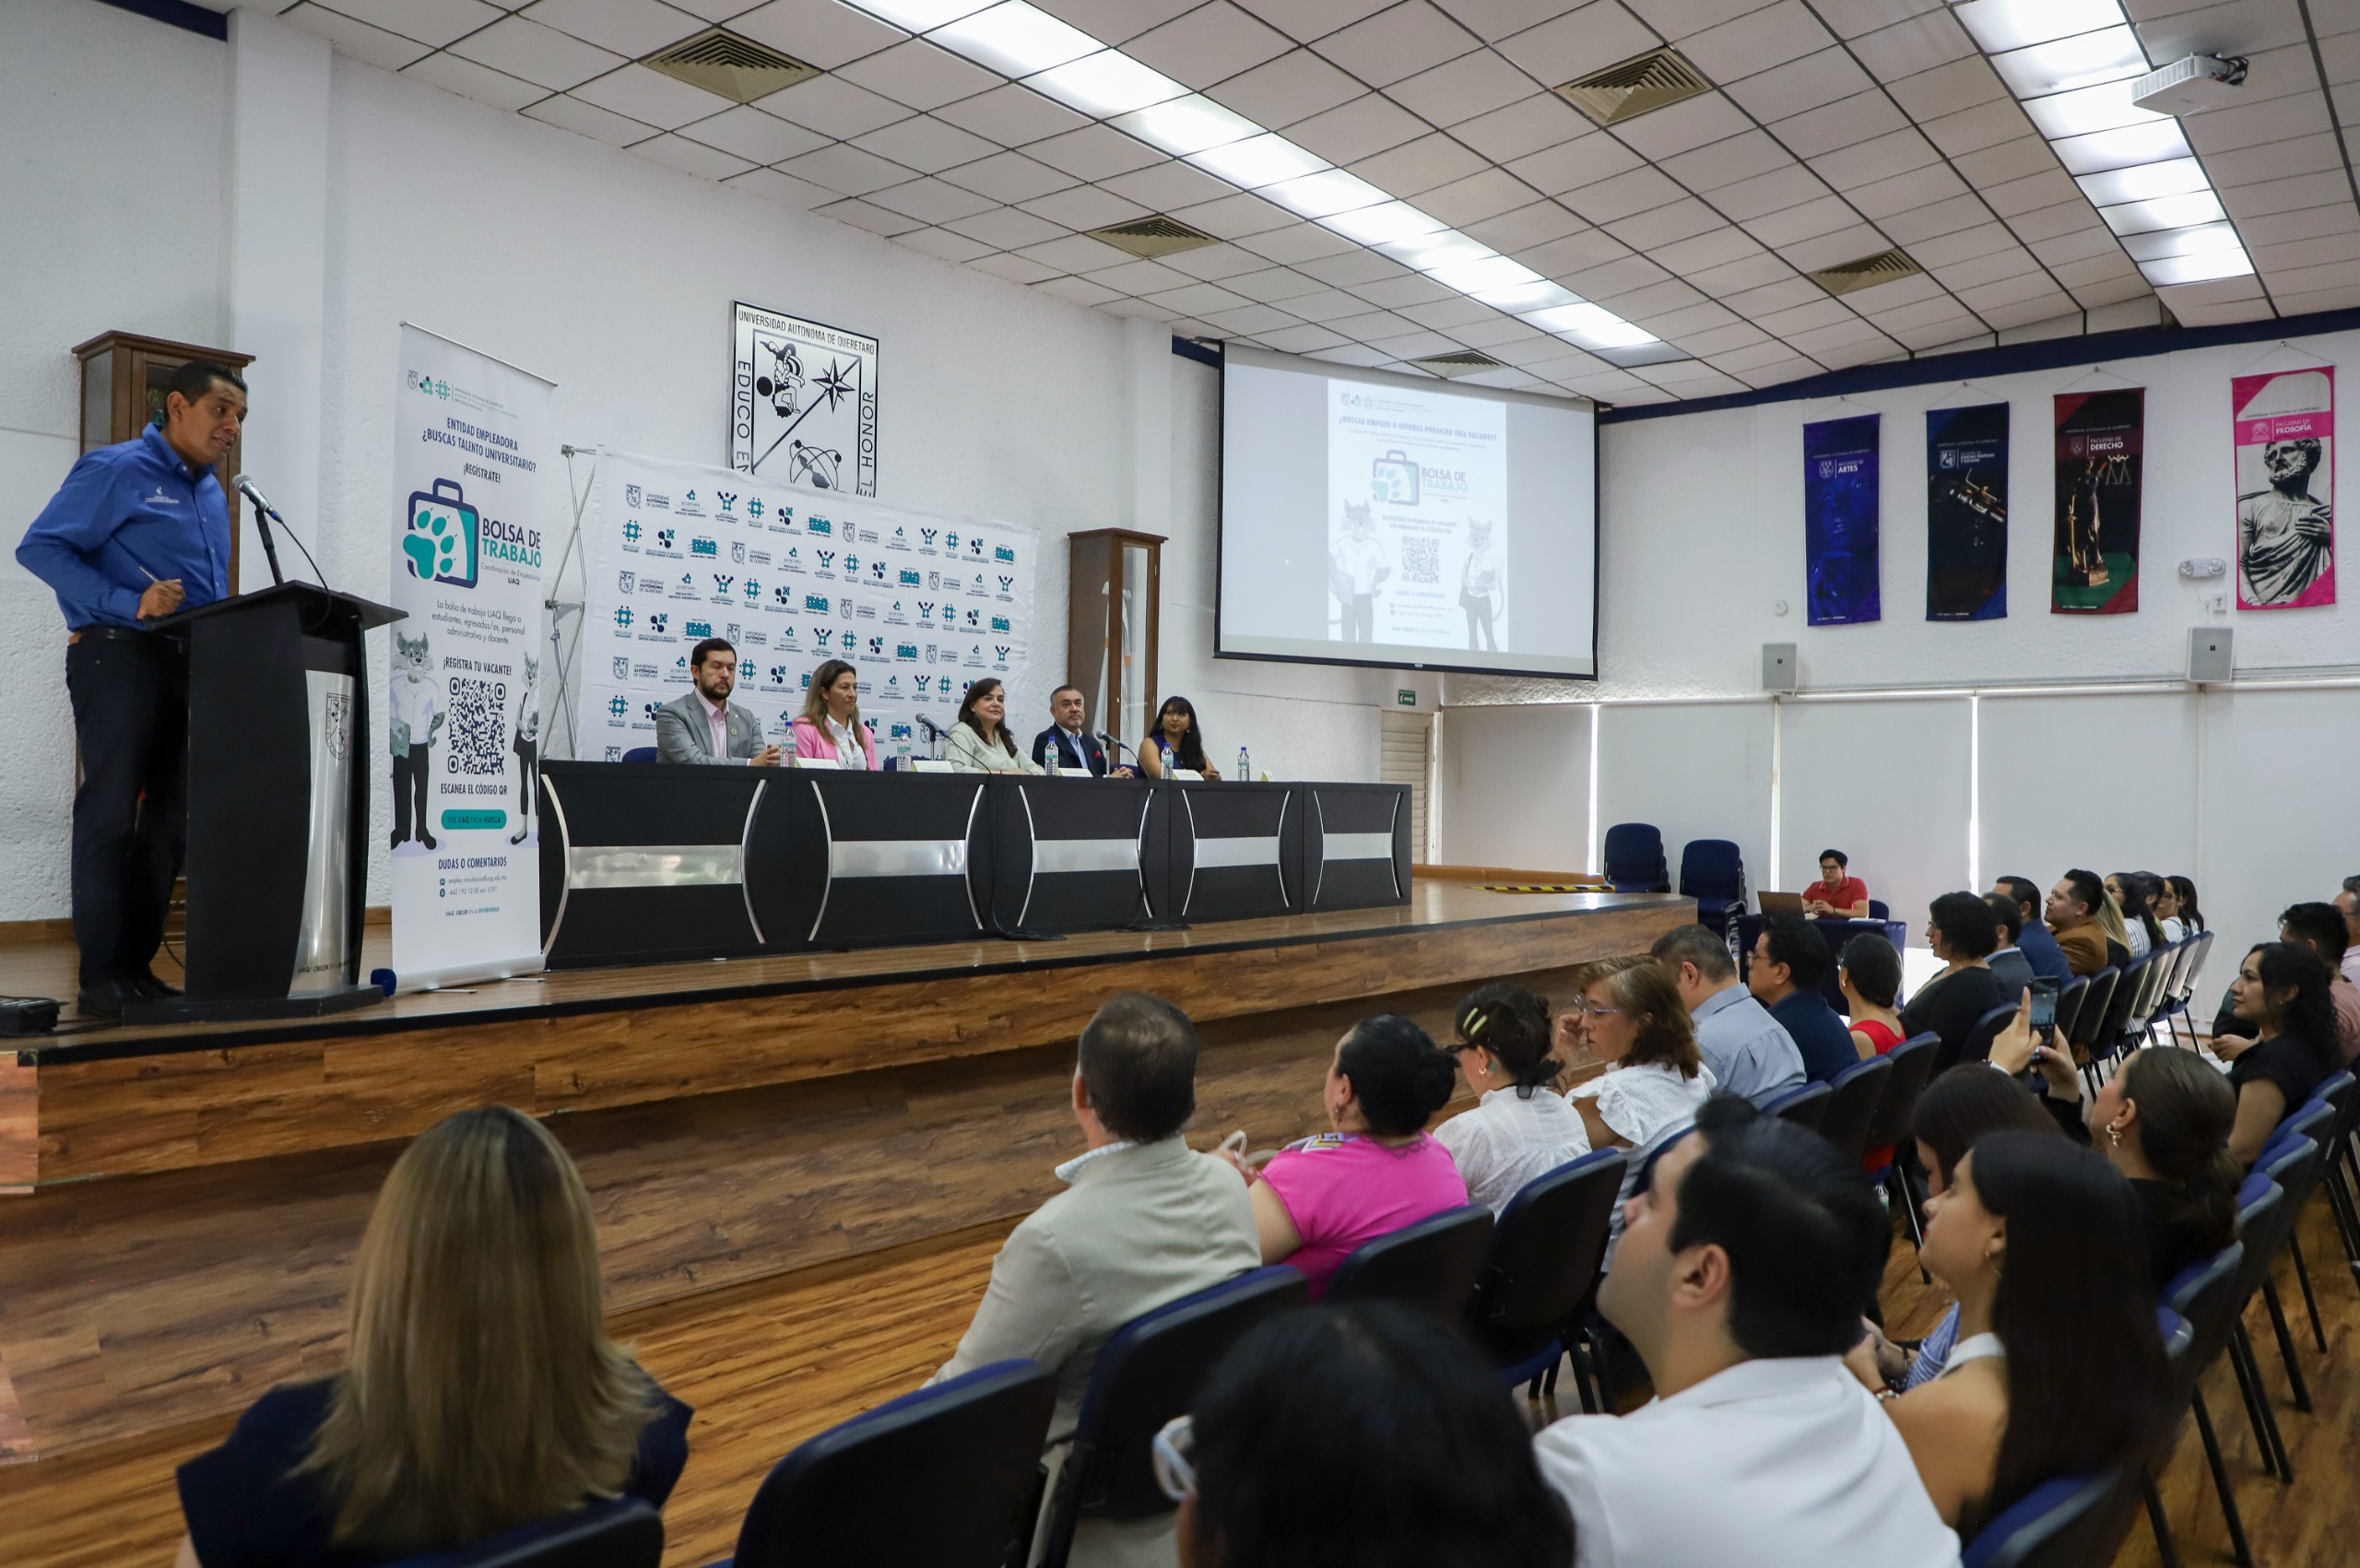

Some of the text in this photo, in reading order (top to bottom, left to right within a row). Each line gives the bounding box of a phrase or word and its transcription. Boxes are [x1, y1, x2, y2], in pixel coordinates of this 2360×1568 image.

[738, 309, 875, 355] UNIVERSIDAD AUTONOMA DE QUERETARO
[737, 360, 751, 439] EDUCO
[447, 417, 518, 452] ENTIDAD EMPLEADORA
[861, 392, 874, 468] HONOR
[1367, 419, 1390, 428] EMPLEO
[1398, 422, 1423, 432] QUIERES
[1424, 426, 1453, 436] PUBLICAR
[1455, 430, 1467, 438] UNA
[1469, 430, 1497, 442] VACANTE?
[422, 428, 537, 473] ¿BUSCAS TALENTO UNIVERSITARIO?
[2090, 442, 2124, 451] DERECHO
[463, 463, 501, 484] ¡REGÍSTRATE!
[1422, 467, 1466, 482] BOLSA DE
[1837, 465, 1858, 474] ARTES
[1422, 478, 1468, 492] TRABAJO
[483, 517, 541, 549] BOLSA DE
[482, 537, 542, 569] TRABAJO
[507, 577, 520, 585] UAQ
[437, 599, 444, 608] La
[444, 600, 459, 612] bolsa
[460, 603, 466, 613] de
[467, 605, 487, 619] trabajo
[488, 608, 502, 619] UAQ
[502, 611, 516, 624] llega
[431, 612, 463, 625] estudiantes,
[502, 626, 525, 635] personal
[447, 626, 481, 641] administrativo
[482, 635, 487, 643] y
[443, 655, 512, 676] ¡REGÍSTRA TU VACANTE!
[441, 783, 507, 796] ESCANEA EL CÓDIGO QR
[439, 856, 507, 870] DUDAS O COMENTARIOS
